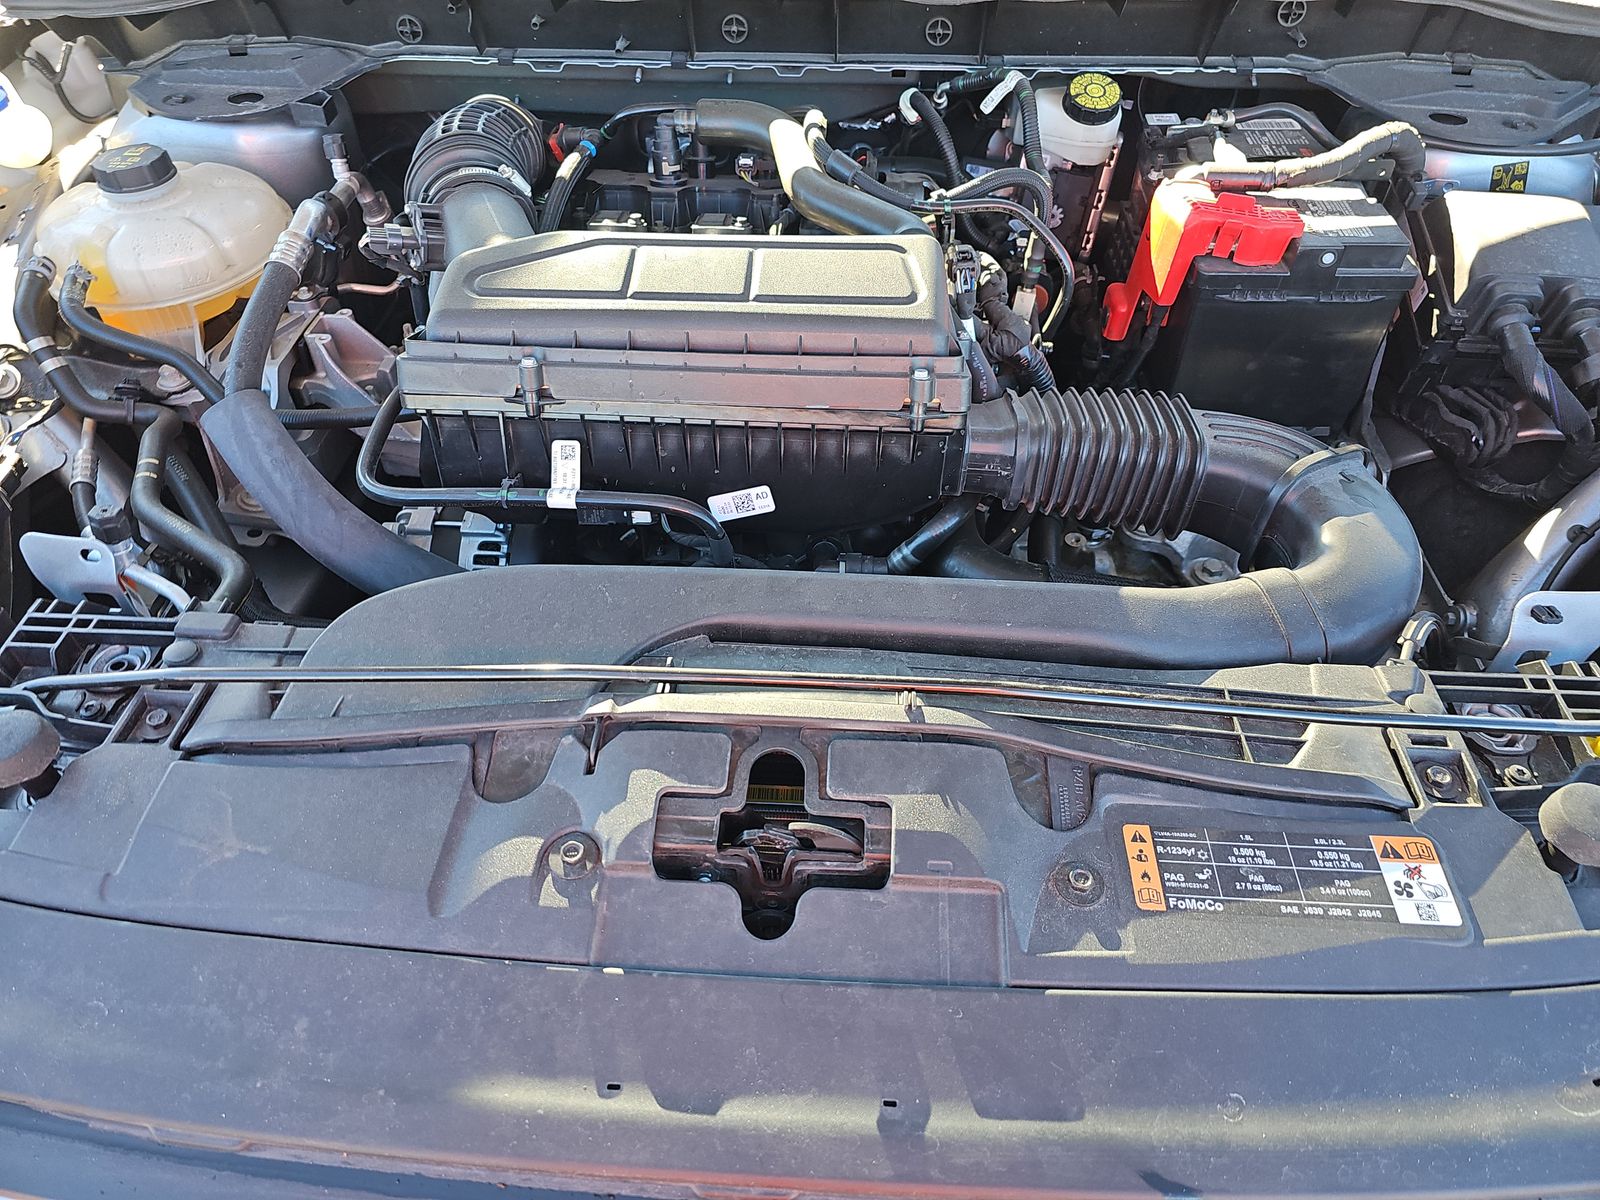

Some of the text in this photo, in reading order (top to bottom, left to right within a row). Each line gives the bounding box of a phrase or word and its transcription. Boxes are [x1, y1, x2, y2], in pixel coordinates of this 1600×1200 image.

[755, 491, 769, 501] AD
[1156, 846, 1196, 857] R-1234yf
[1233, 847, 1266, 858] 0.500 kg
[1316, 850, 1350, 861] 0.550 kg
[1163, 872, 1185, 882] PAG
[1248, 873, 1265, 882] PAG
[1334, 879, 1351, 888] PAG
[1168, 897, 1224, 911] FoMoCo
[1280, 905, 1300, 914] SAE
